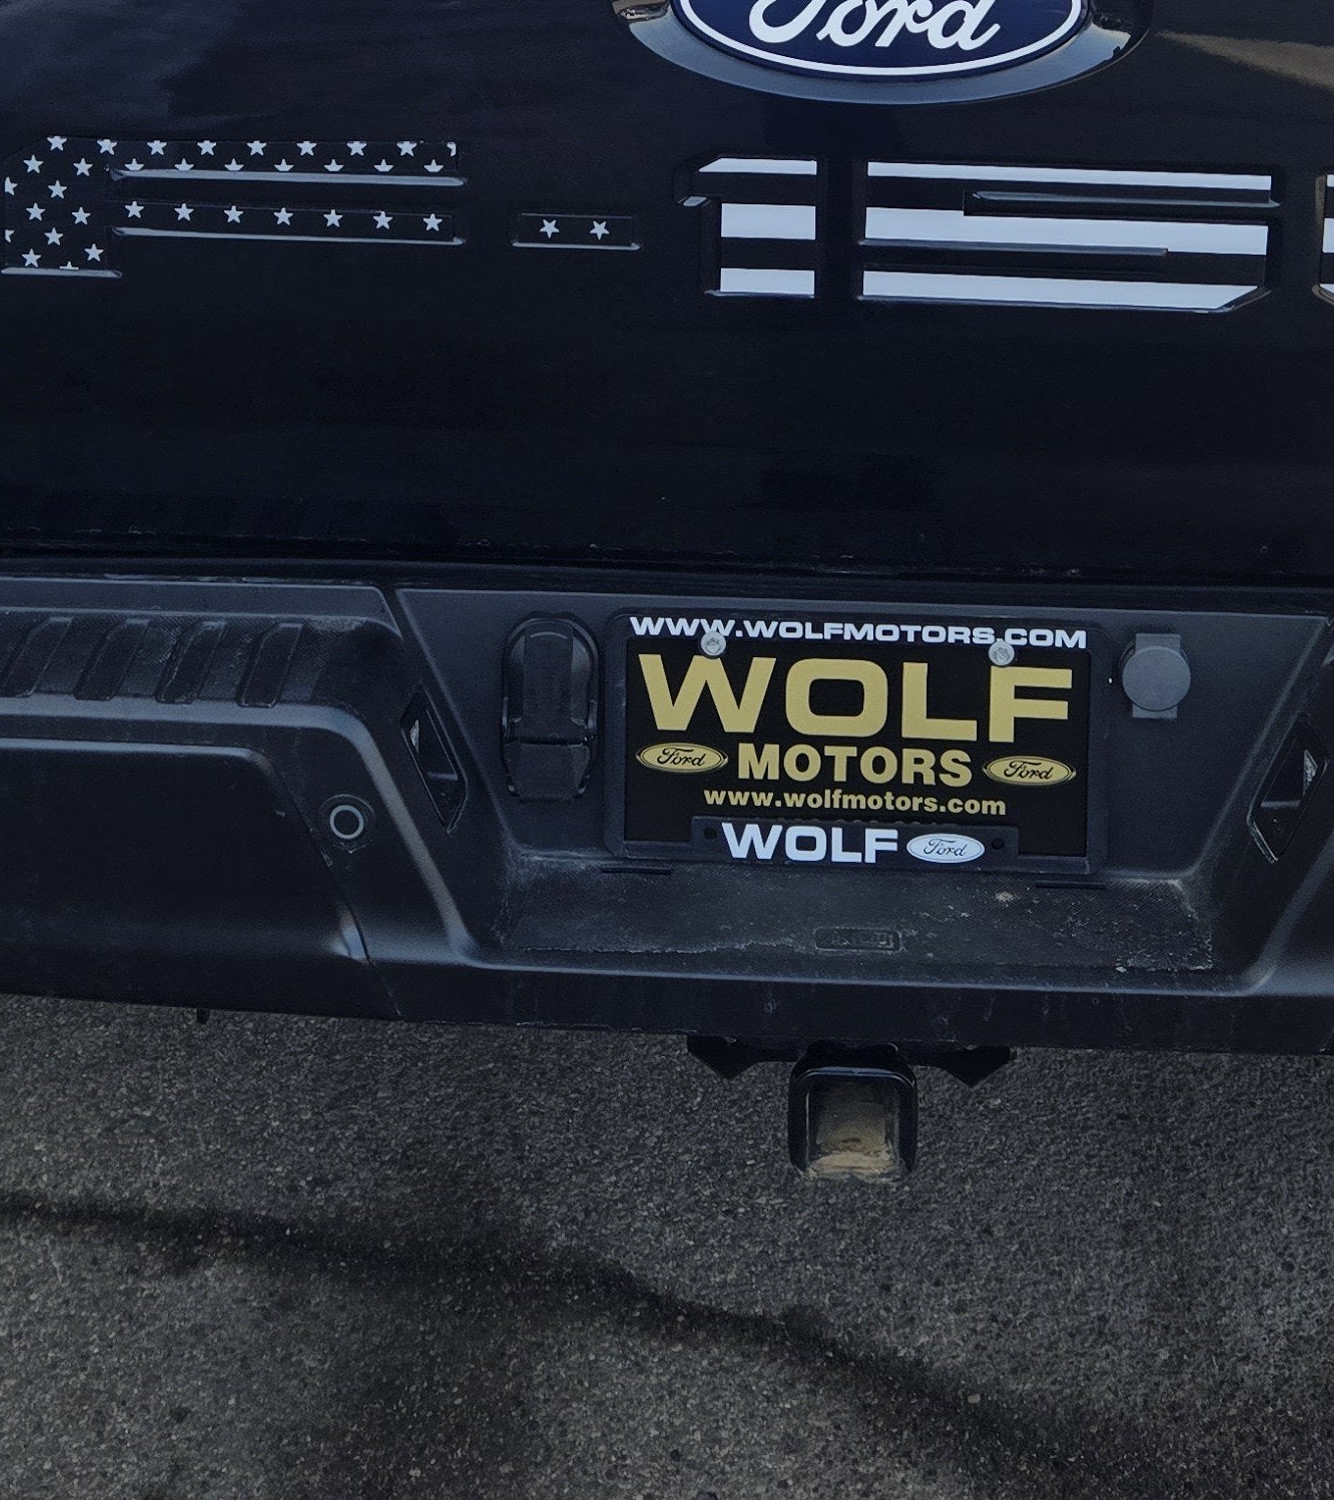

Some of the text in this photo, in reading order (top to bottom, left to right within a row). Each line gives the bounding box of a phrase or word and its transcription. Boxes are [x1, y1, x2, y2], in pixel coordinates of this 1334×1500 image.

[629, 616, 1087, 649] WWW.WOLFMOTORS.COM
[637, 653, 1073, 743] WOLF
[656, 747, 707, 767] Ford
[737, 742, 973, 788] MOTORS
[1003, 760, 1054, 781] Ford
[703, 788, 1007, 816] www.wolfmotors.com
[721, 821, 899, 864] WOLF
[922, 838, 967, 857] Ford
